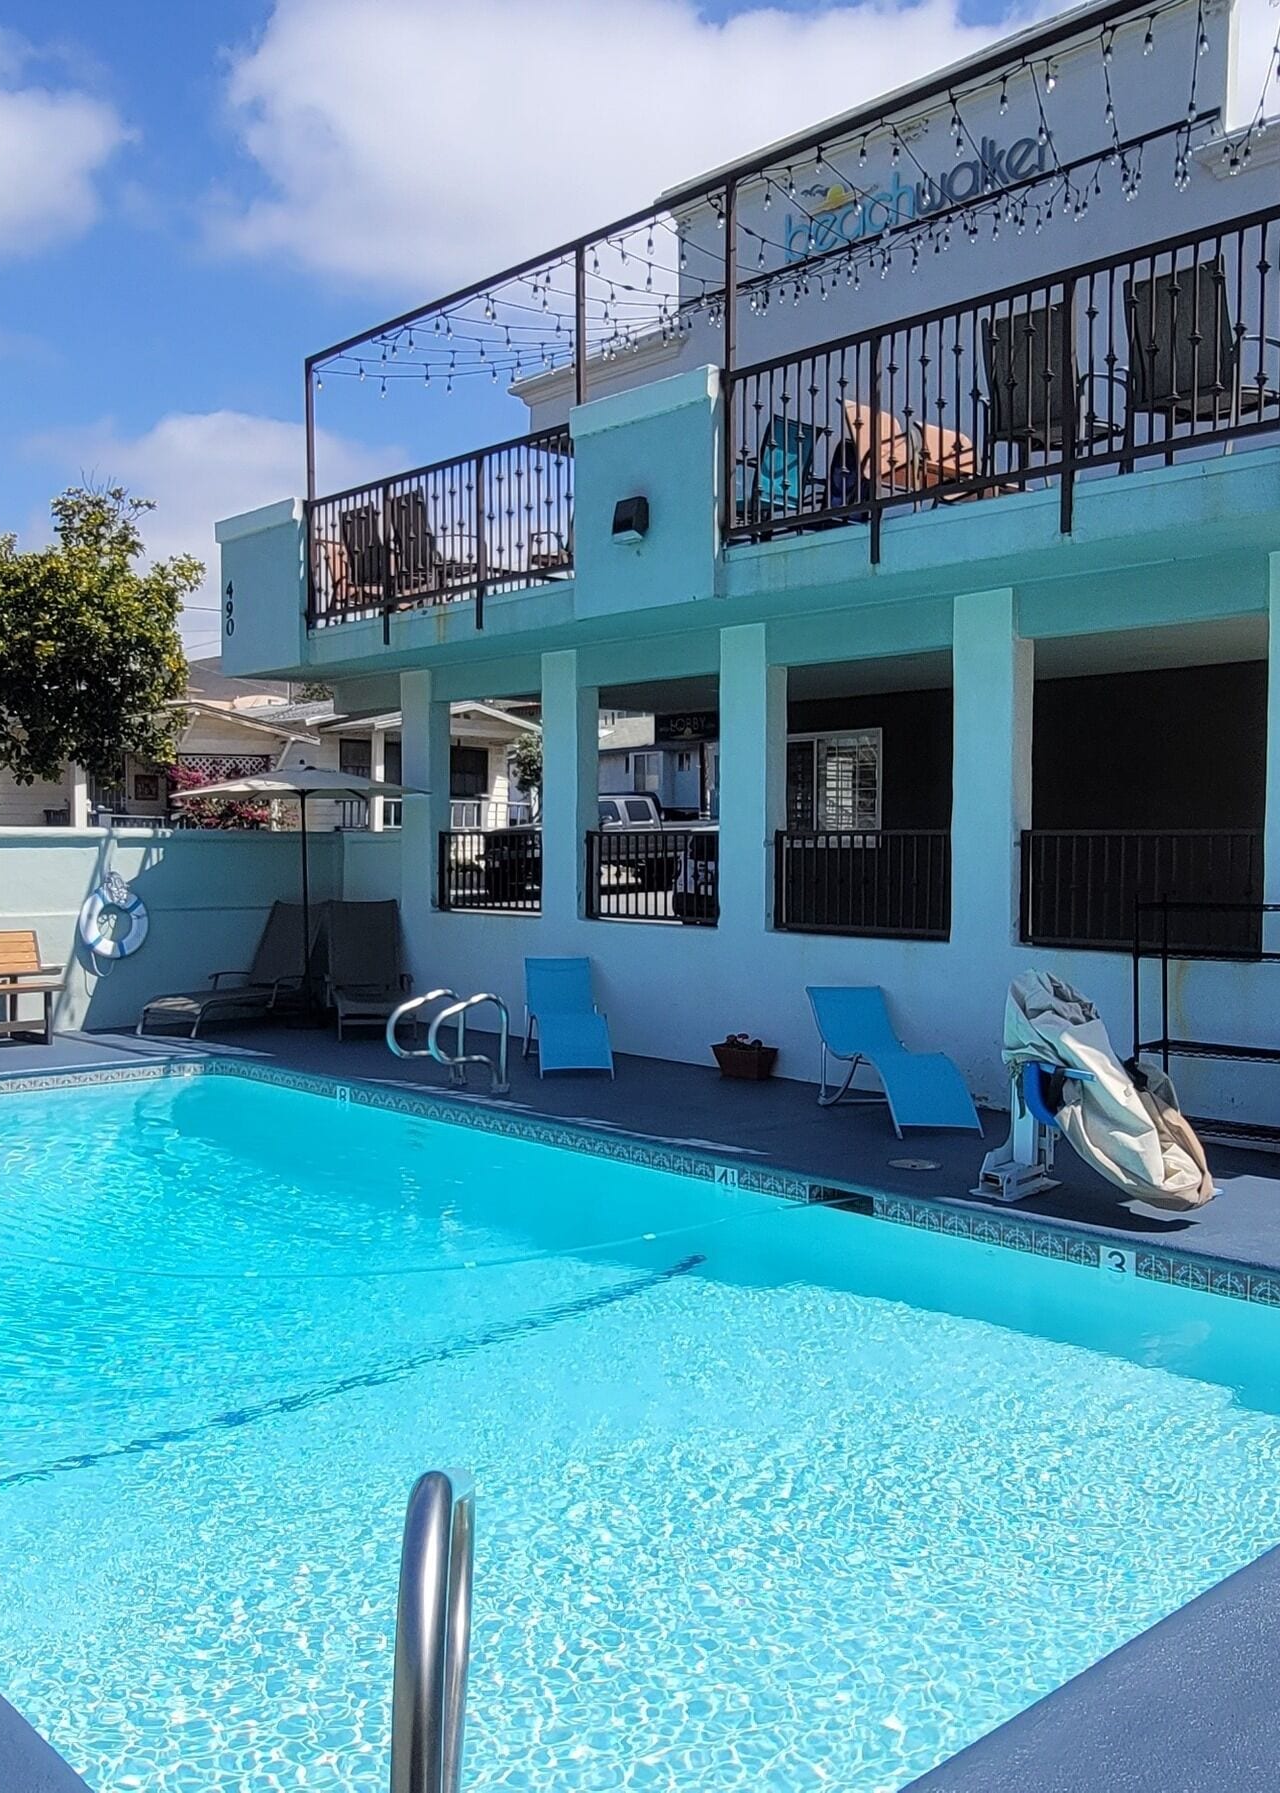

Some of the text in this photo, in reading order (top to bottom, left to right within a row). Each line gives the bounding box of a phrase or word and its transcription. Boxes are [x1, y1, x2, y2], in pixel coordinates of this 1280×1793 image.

[784, 131, 1053, 264] beachwalker
[225, 580, 235, 637] 490
[1107, 1250, 1128, 1274] 3
